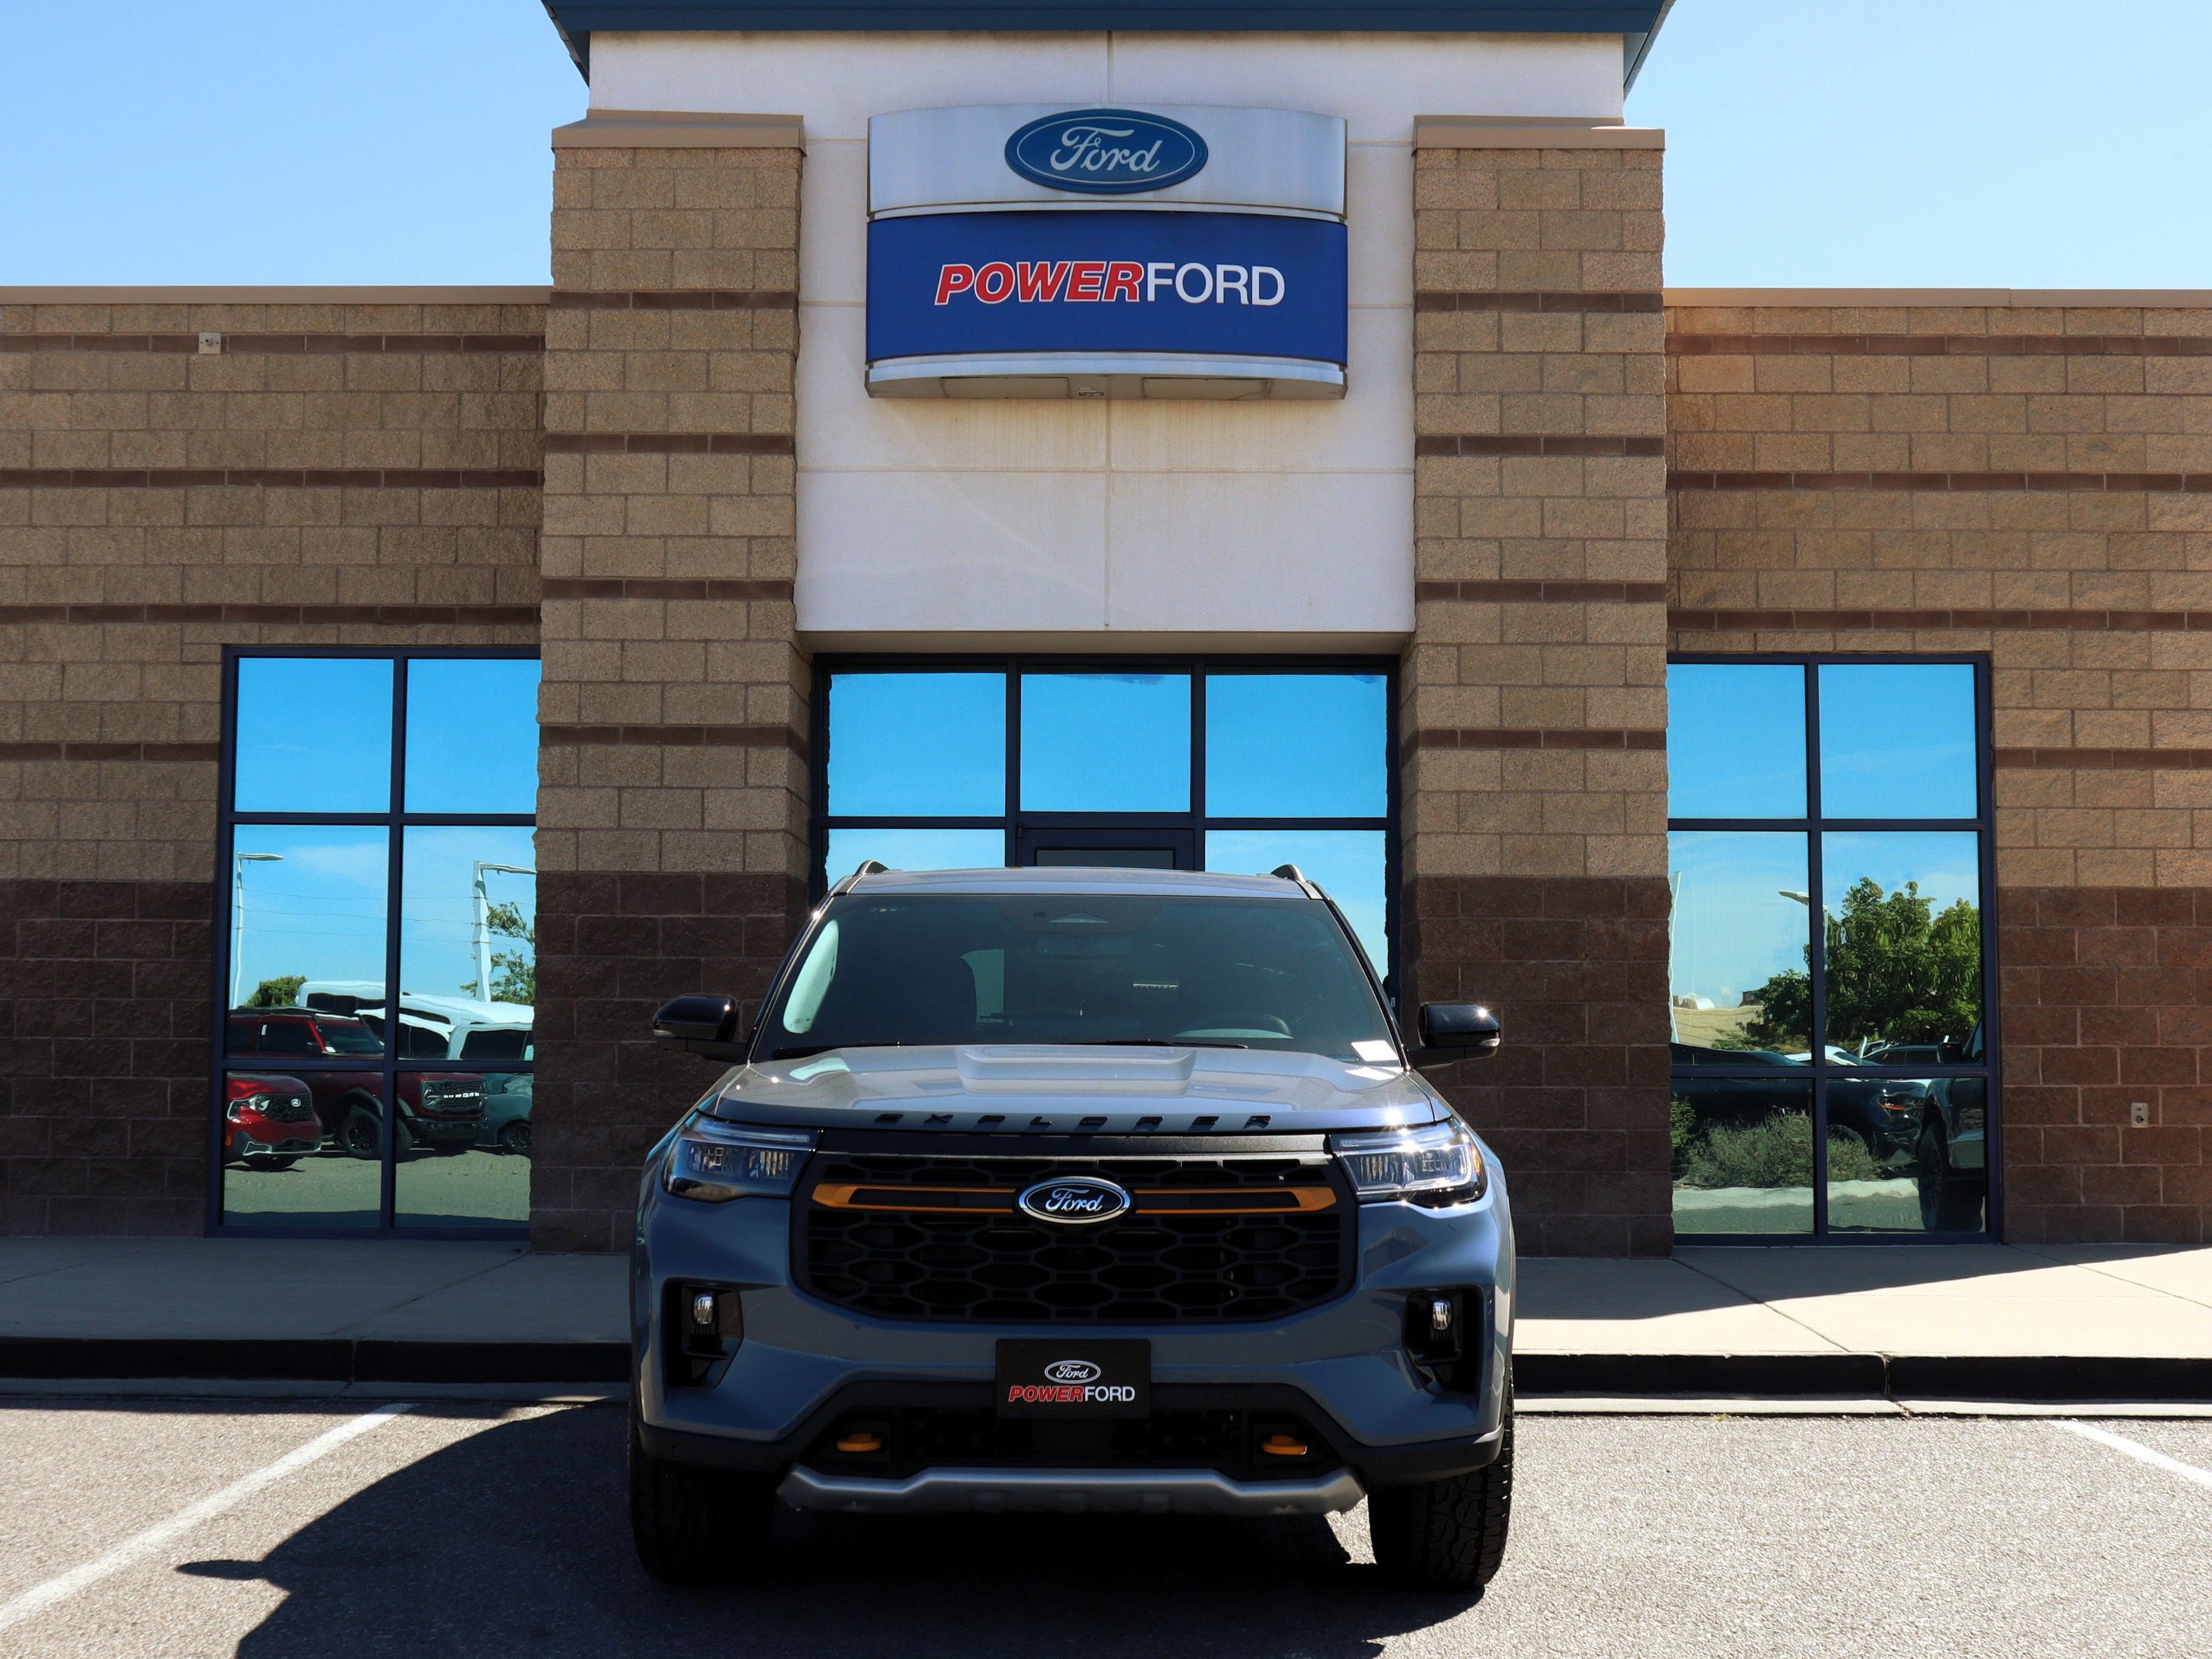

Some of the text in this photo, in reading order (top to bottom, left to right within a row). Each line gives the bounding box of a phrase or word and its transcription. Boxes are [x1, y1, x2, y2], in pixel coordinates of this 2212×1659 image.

[1050, 126, 1161, 173] Ford
[934, 261, 1286, 307] POWERFORD
[1045, 1188, 1104, 1212] Ford
[1055, 1364, 1089, 1378] Ford
[1008, 1385, 1136, 1402] POWERFORD
